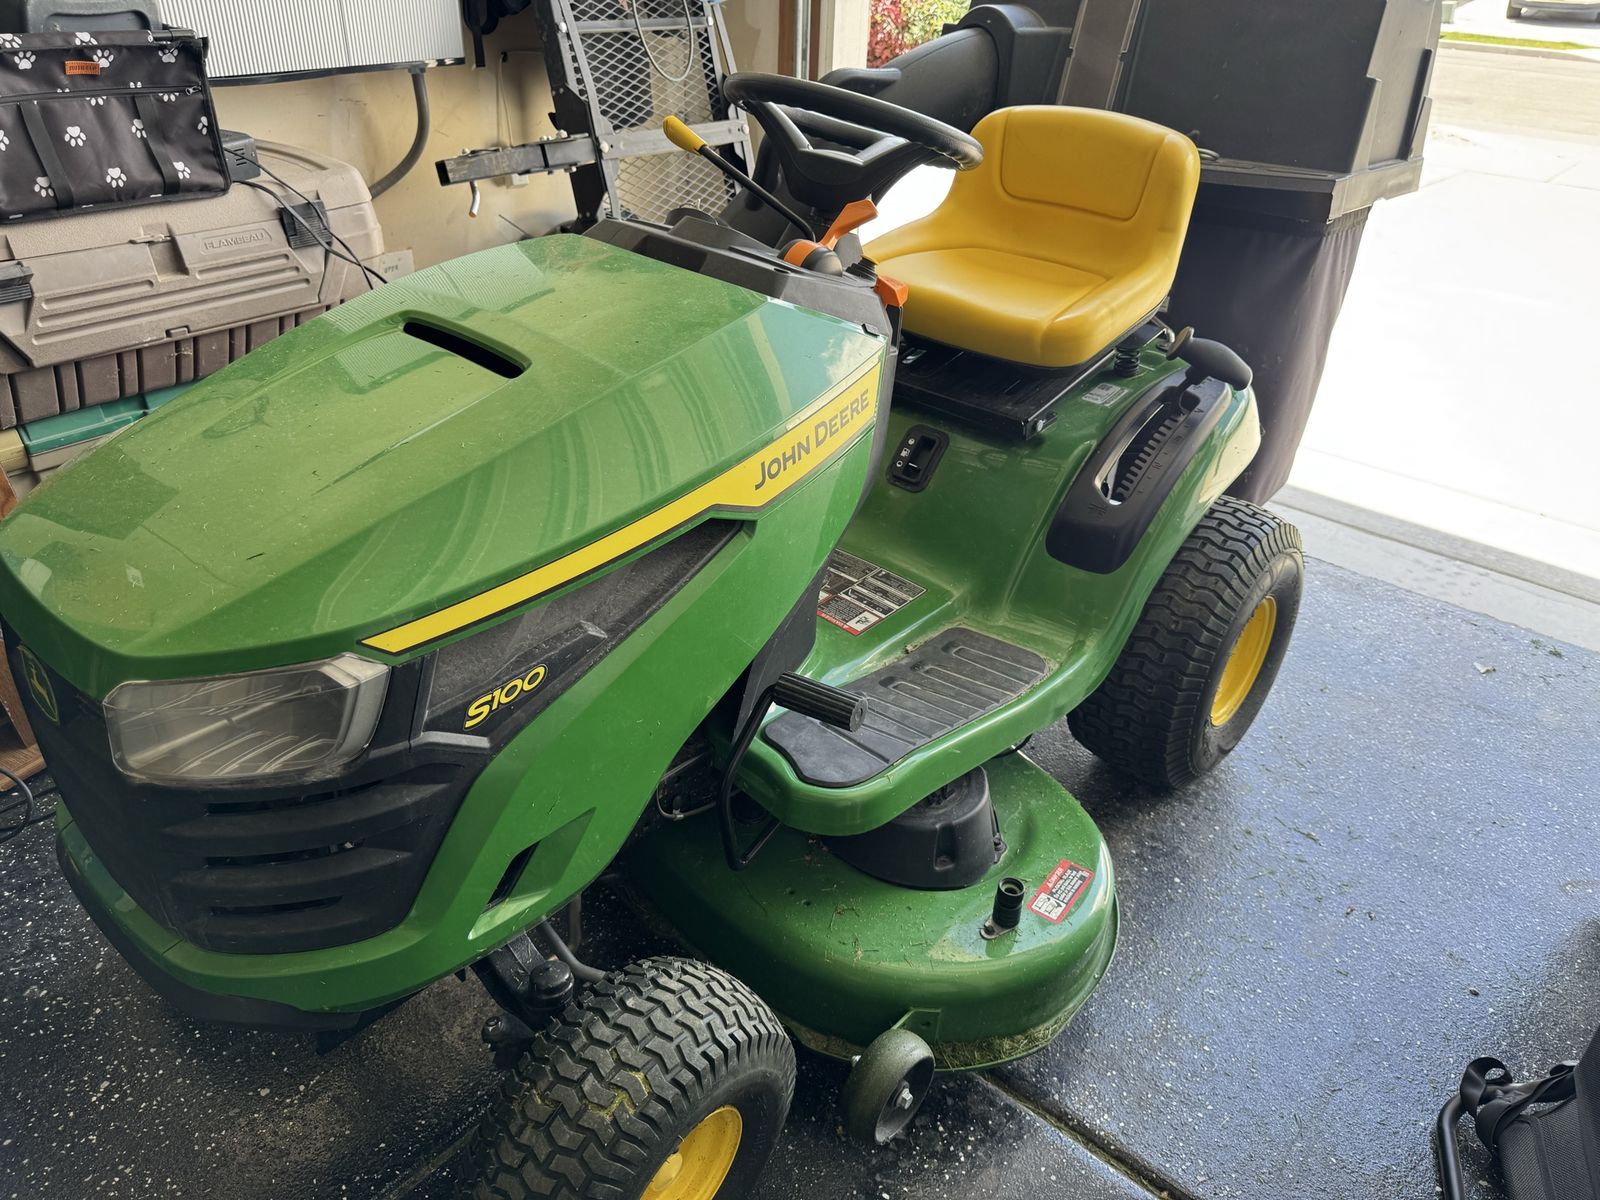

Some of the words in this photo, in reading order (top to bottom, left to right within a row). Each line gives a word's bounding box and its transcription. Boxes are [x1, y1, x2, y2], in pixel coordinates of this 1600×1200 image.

[203, 232, 265, 250] FLAMBEAU
[754, 435, 811, 491] JOHN
[815, 388, 870, 449] DEERE
[464, 665, 546, 729] S100
